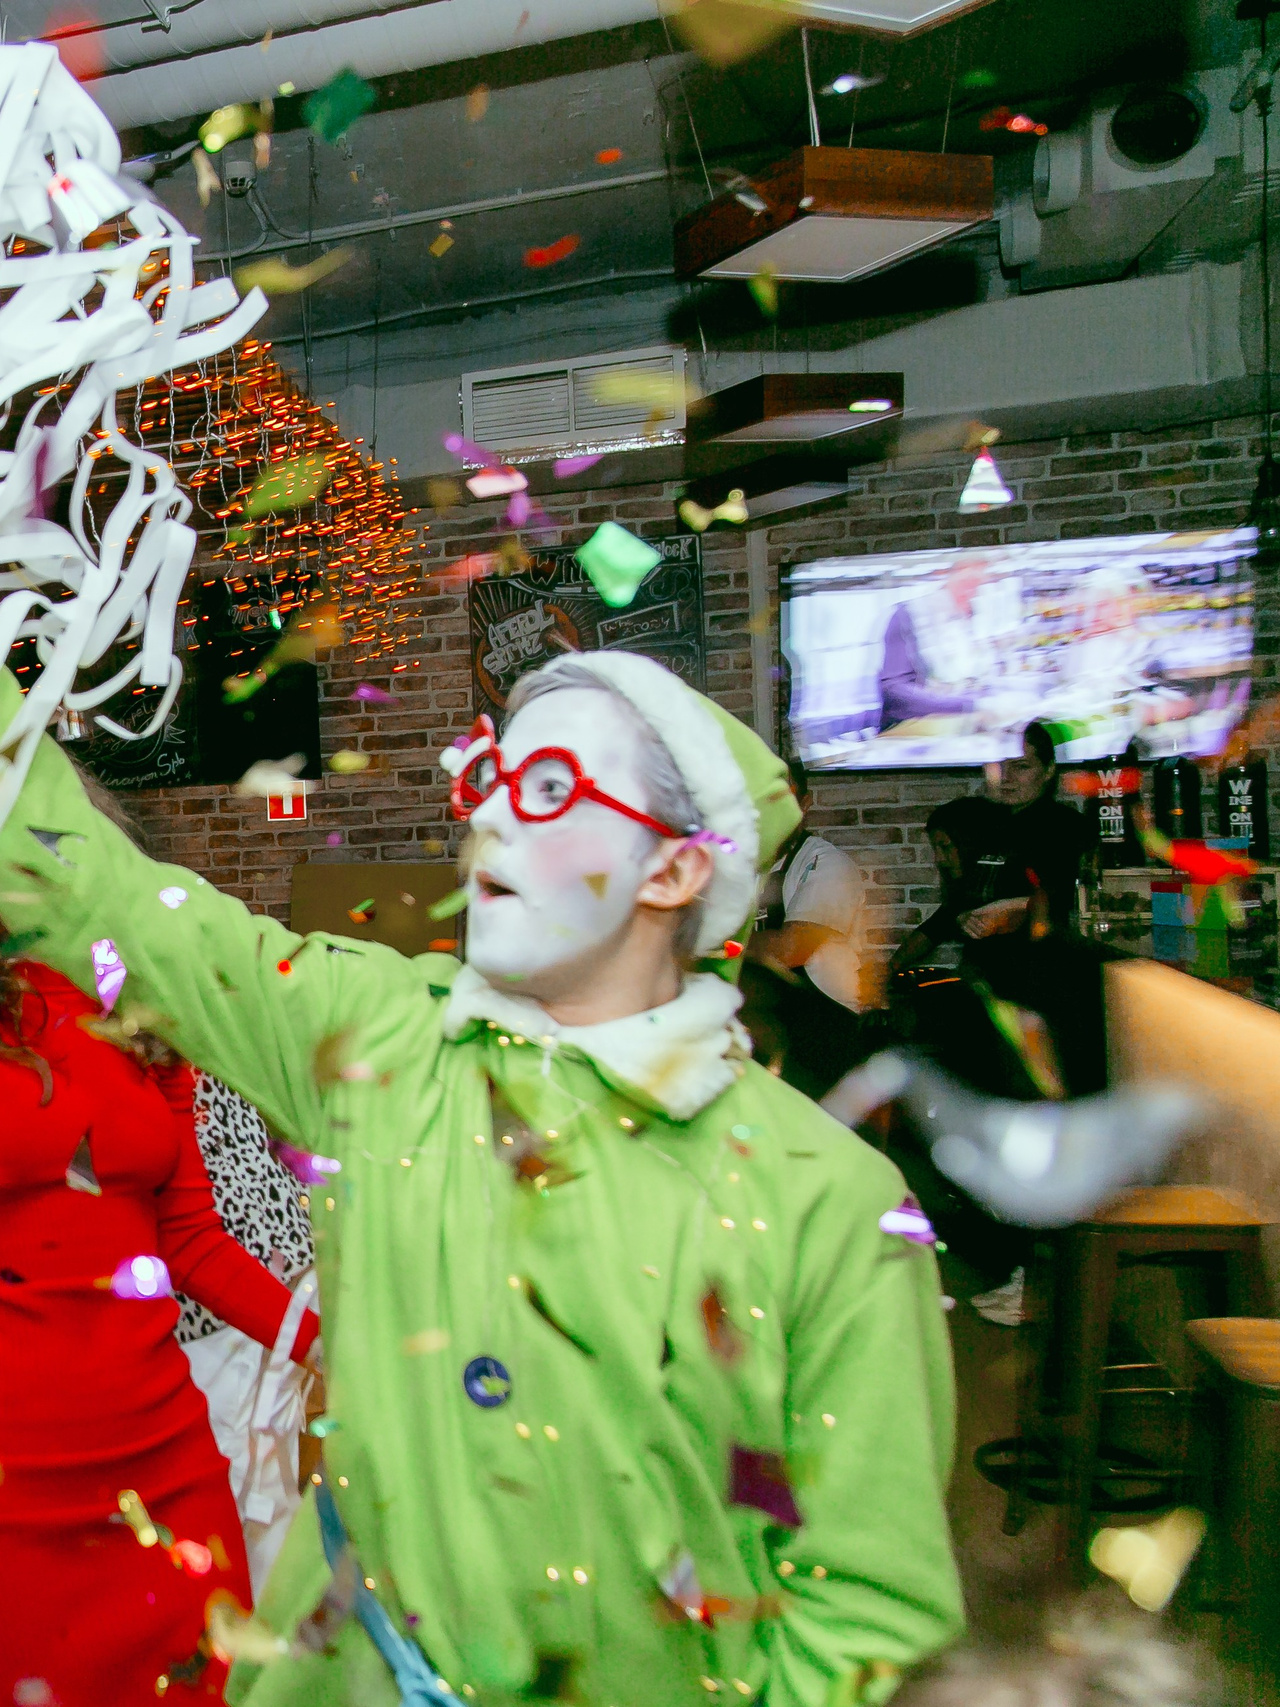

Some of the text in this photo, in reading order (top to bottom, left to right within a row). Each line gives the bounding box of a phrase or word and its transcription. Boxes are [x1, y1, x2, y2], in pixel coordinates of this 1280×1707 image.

[1097, 769, 1122, 786] W
[1098, 786, 1124, 798] INE
[1228, 779, 1252, 795] W
[1229, 795, 1253, 806] INE
[1099, 805, 1122, 817] ON
[1229, 812, 1252, 822] ON
